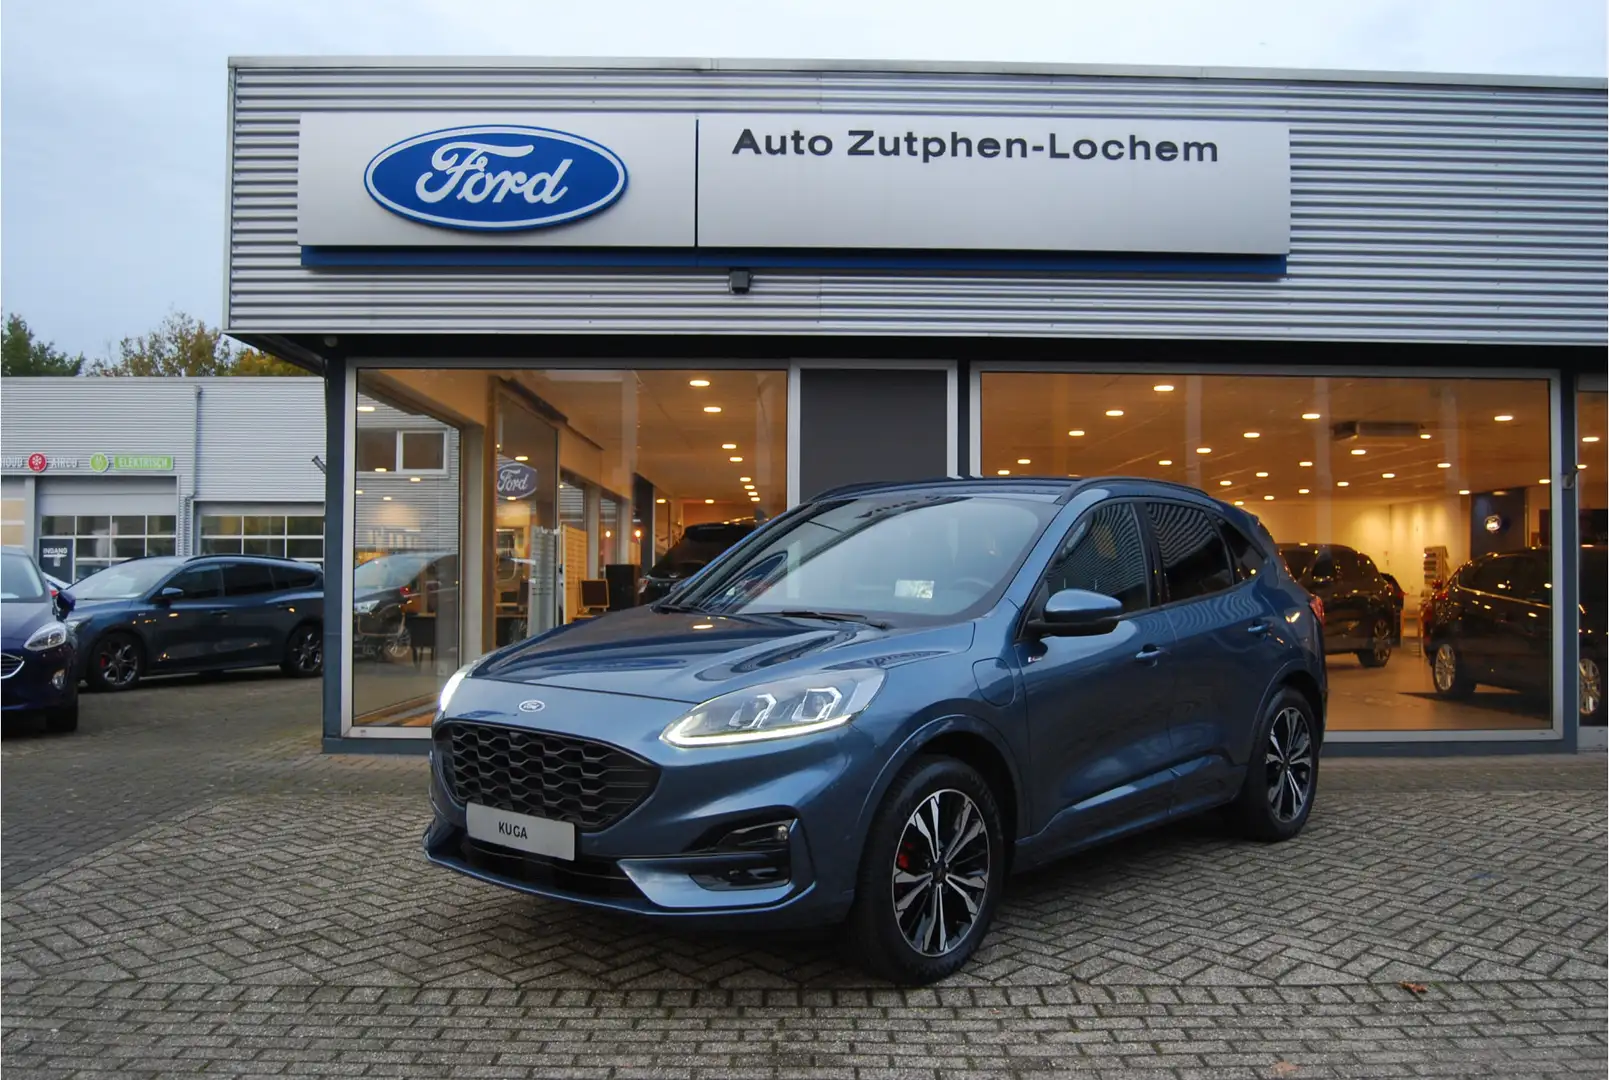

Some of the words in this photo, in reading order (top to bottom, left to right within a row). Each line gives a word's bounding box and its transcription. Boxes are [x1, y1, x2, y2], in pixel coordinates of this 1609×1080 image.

[732, 128, 833, 156] Auto
[847, 129, 1219, 164] Zutphen-Lochem
[415, 141, 573, 204] Ford
[51, 456, 78, 468] AIRCO
[118, 457, 168, 469] ELEKTRISCH
[497, 469, 529, 492] Ford
[498, 821, 528, 839] KUGA
